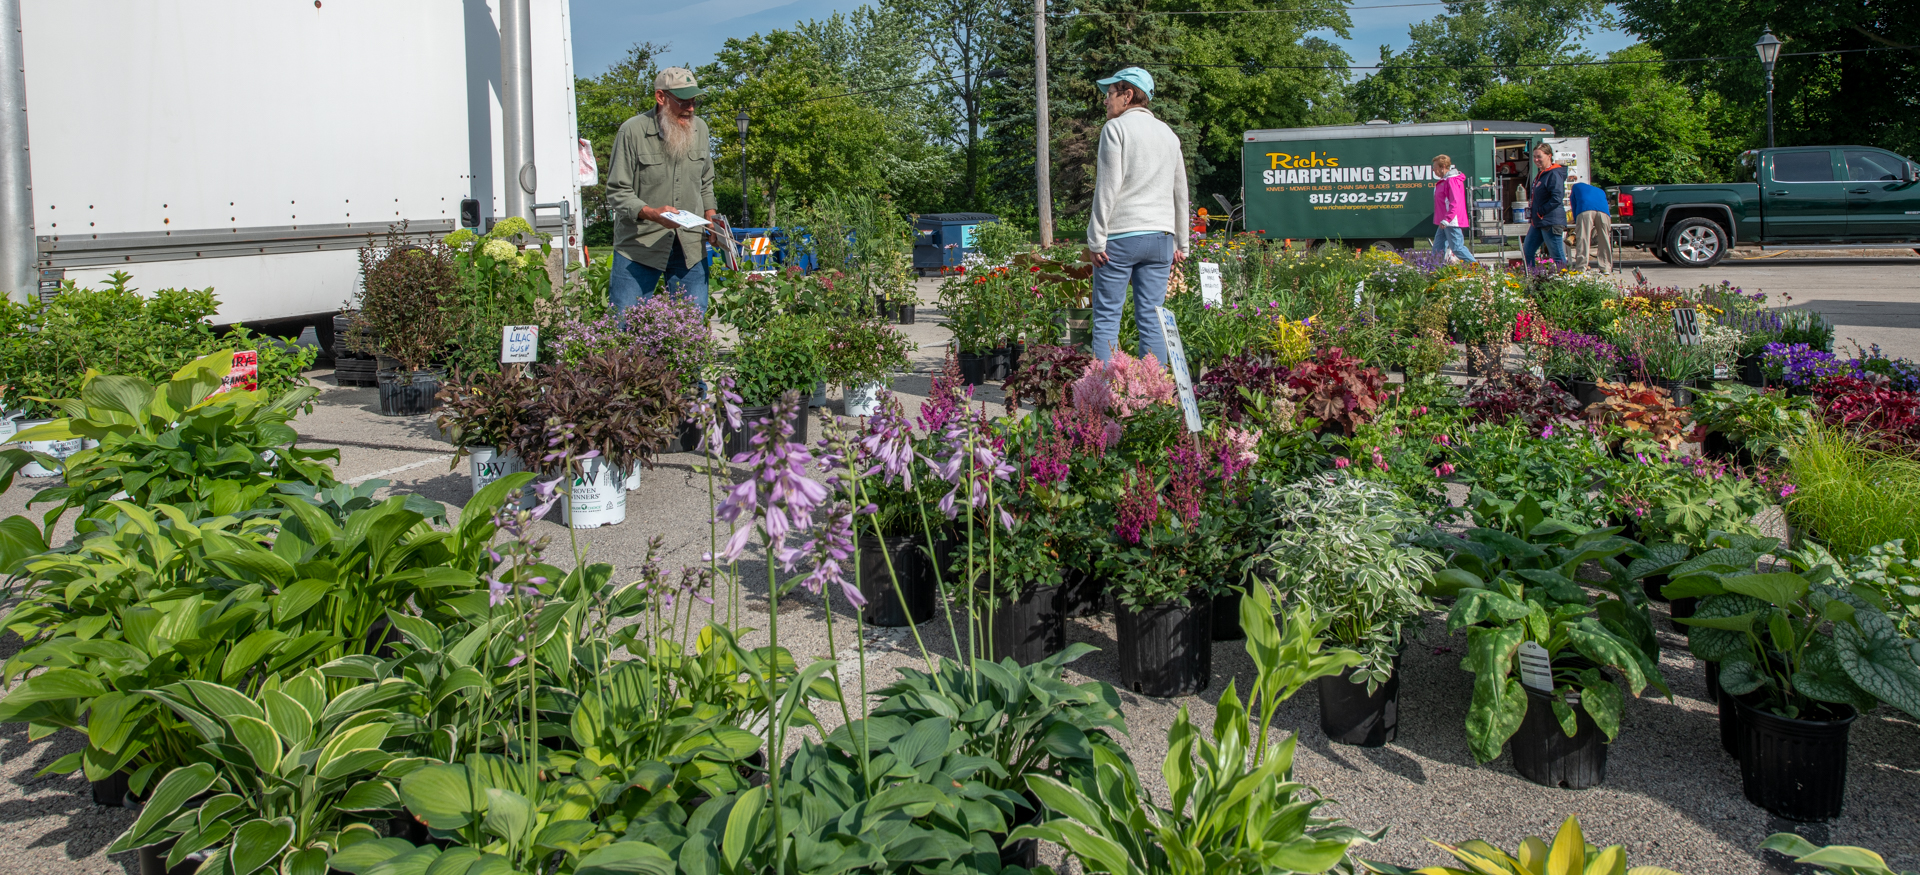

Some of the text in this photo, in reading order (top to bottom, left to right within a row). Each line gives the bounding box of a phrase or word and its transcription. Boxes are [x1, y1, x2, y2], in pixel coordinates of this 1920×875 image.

[1265, 151, 1339, 170] Rich's
[1263, 165, 1455, 185] SHARPENING SERVI
[1309, 192, 1408, 204] 815/302-5757
[509, 332, 531, 342] LILAC
[509, 344, 530, 352] BUSH
[476, 461, 507, 477] PW
